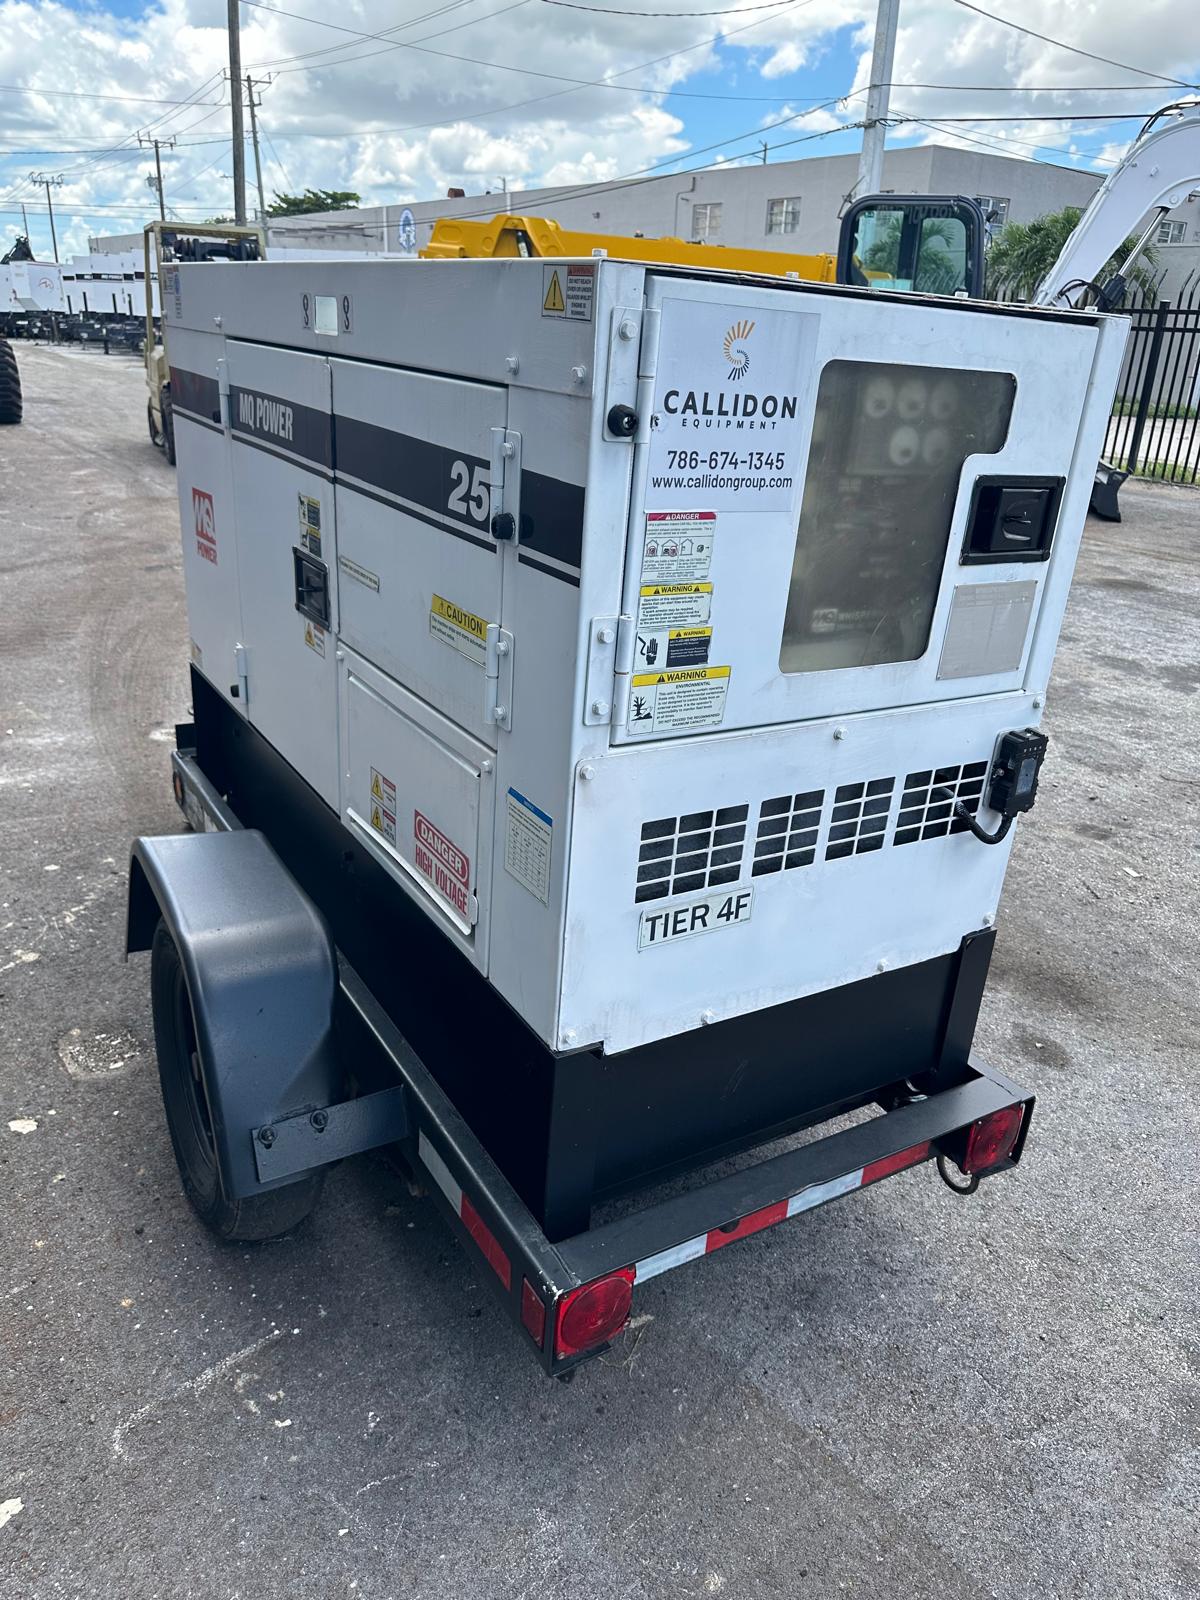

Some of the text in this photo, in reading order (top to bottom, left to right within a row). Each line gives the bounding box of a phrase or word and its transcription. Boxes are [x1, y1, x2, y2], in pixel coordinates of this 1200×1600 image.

[240, 393, 293, 440] MQ POWER
[664, 390, 797, 419] CALLIDON
[682, 419, 777, 430] EQUIPMENT
[667, 451, 785, 470] 786-674-1345
[448, 460, 490, 521] 25
[652, 474, 792, 491] www.callidongroup.com
[197, 540, 218, 566] POWER
[447, 605, 482, 635] CAUTION
[667, 671, 707, 681] WARNING
[421, 825, 462, 875] DANGER
[416, 844, 467, 915] HIGH VOLTAGE
[646, 893, 750, 941] TIER 4F
